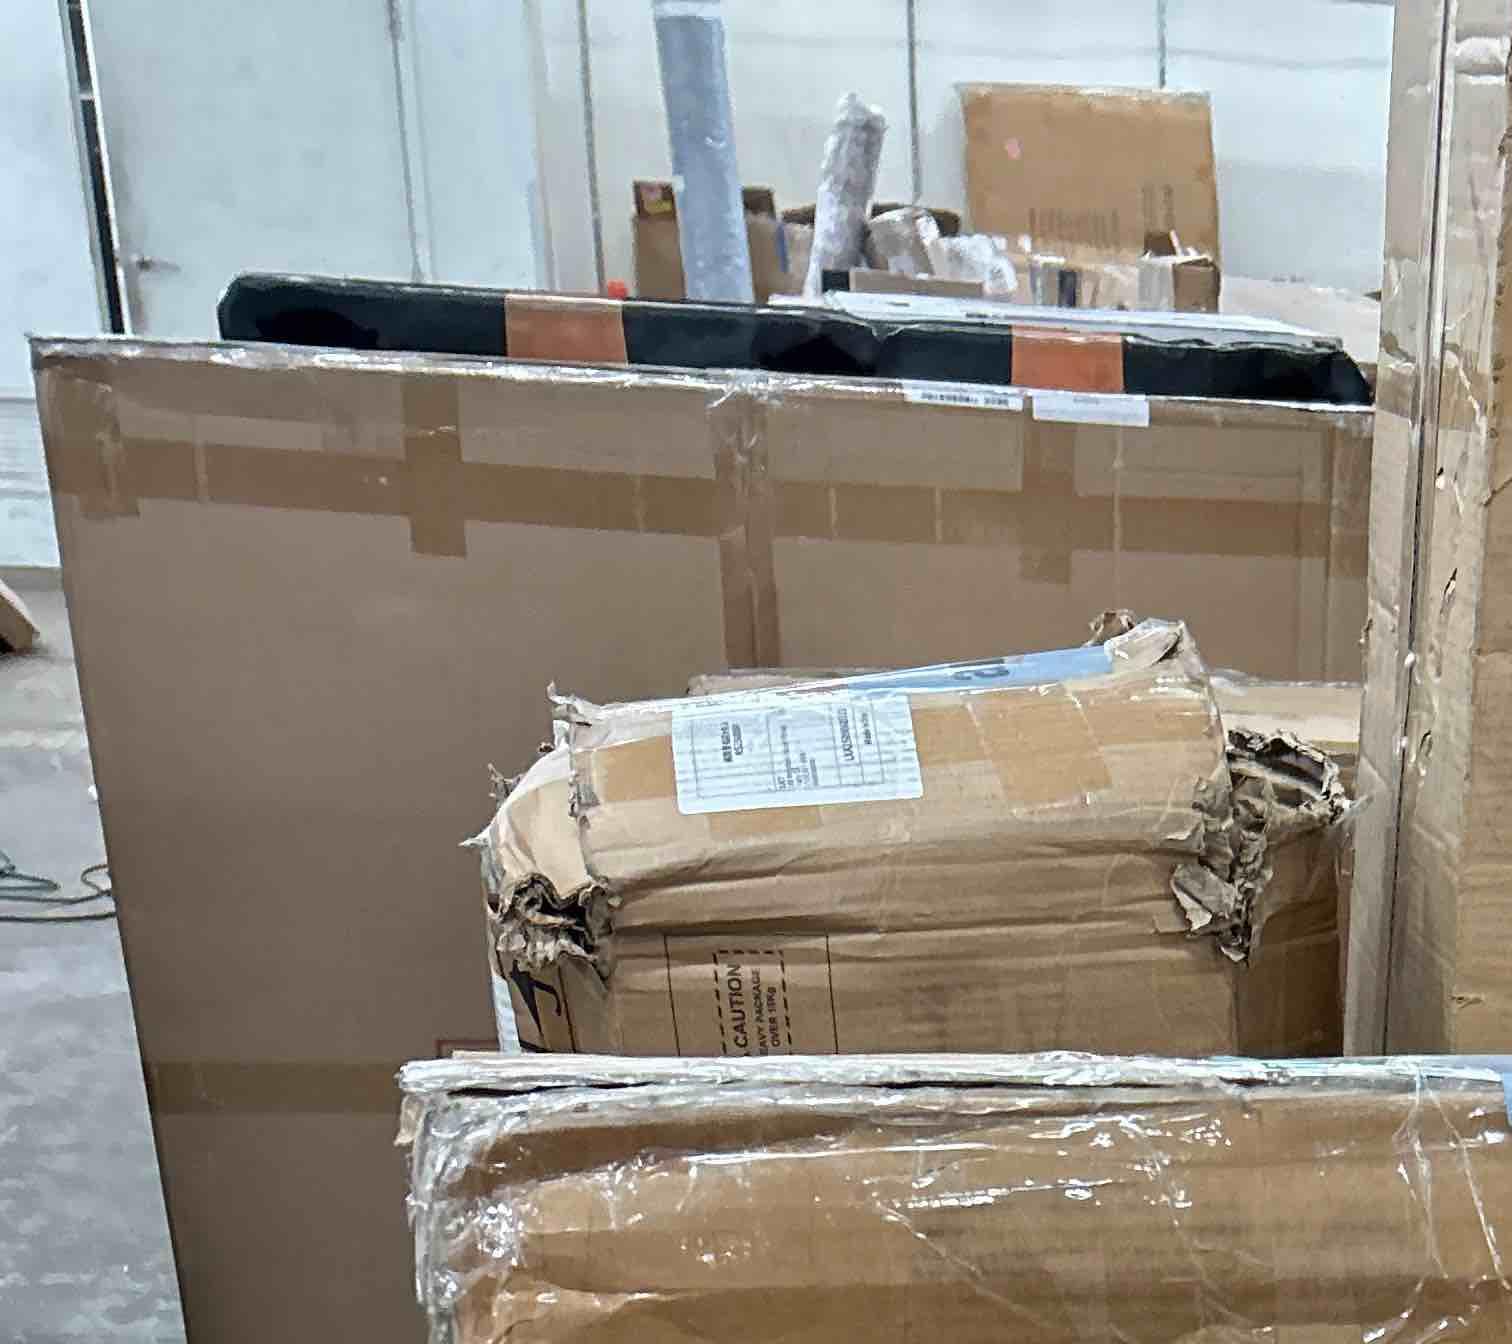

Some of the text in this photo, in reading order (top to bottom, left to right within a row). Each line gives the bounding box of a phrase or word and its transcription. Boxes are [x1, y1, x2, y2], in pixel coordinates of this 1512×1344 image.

[727, 963, 748, 1048] CAUTION
[751, 968, 765, 1022] PACKAGE
[767, 1016, 781, 1047] OVER
